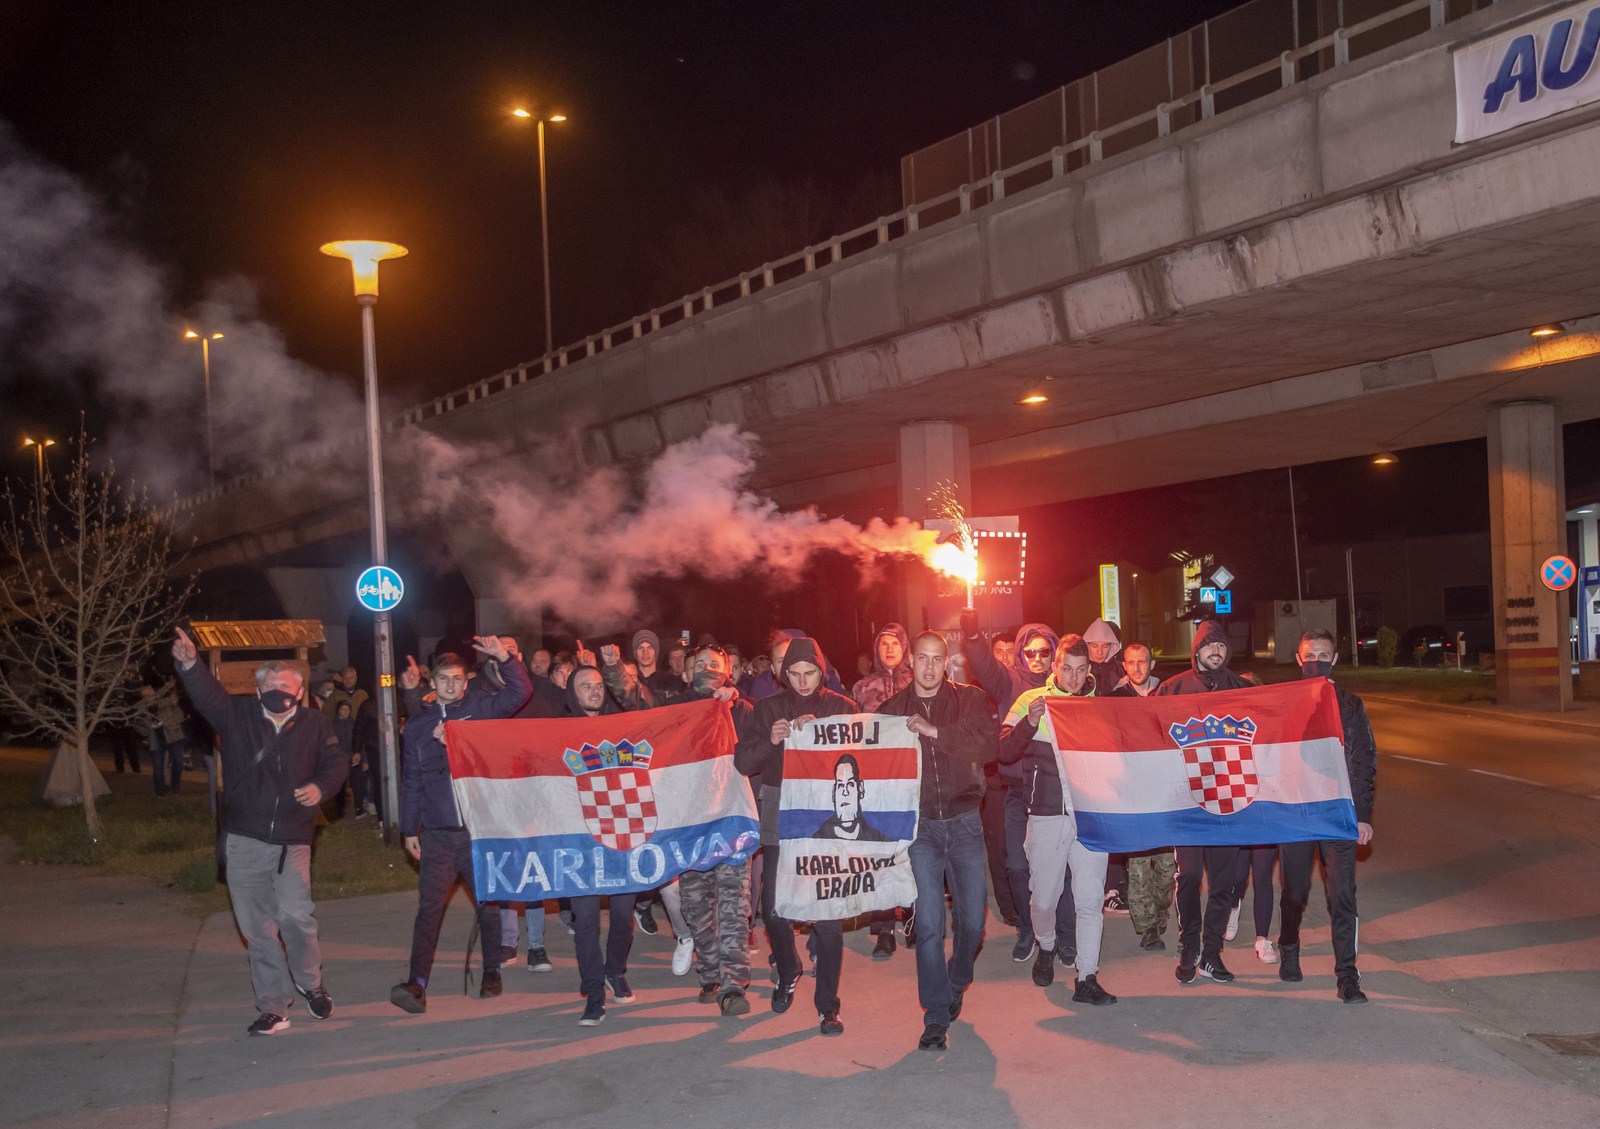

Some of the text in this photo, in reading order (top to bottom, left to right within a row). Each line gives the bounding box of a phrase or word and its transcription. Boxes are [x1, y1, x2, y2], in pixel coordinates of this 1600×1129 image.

[1482, 6, 1600, 114] AU
[813, 721, 880, 745] HEROJ
[486, 831, 760, 894] KARLOVAC
[815, 871, 876, 900] GRADA
